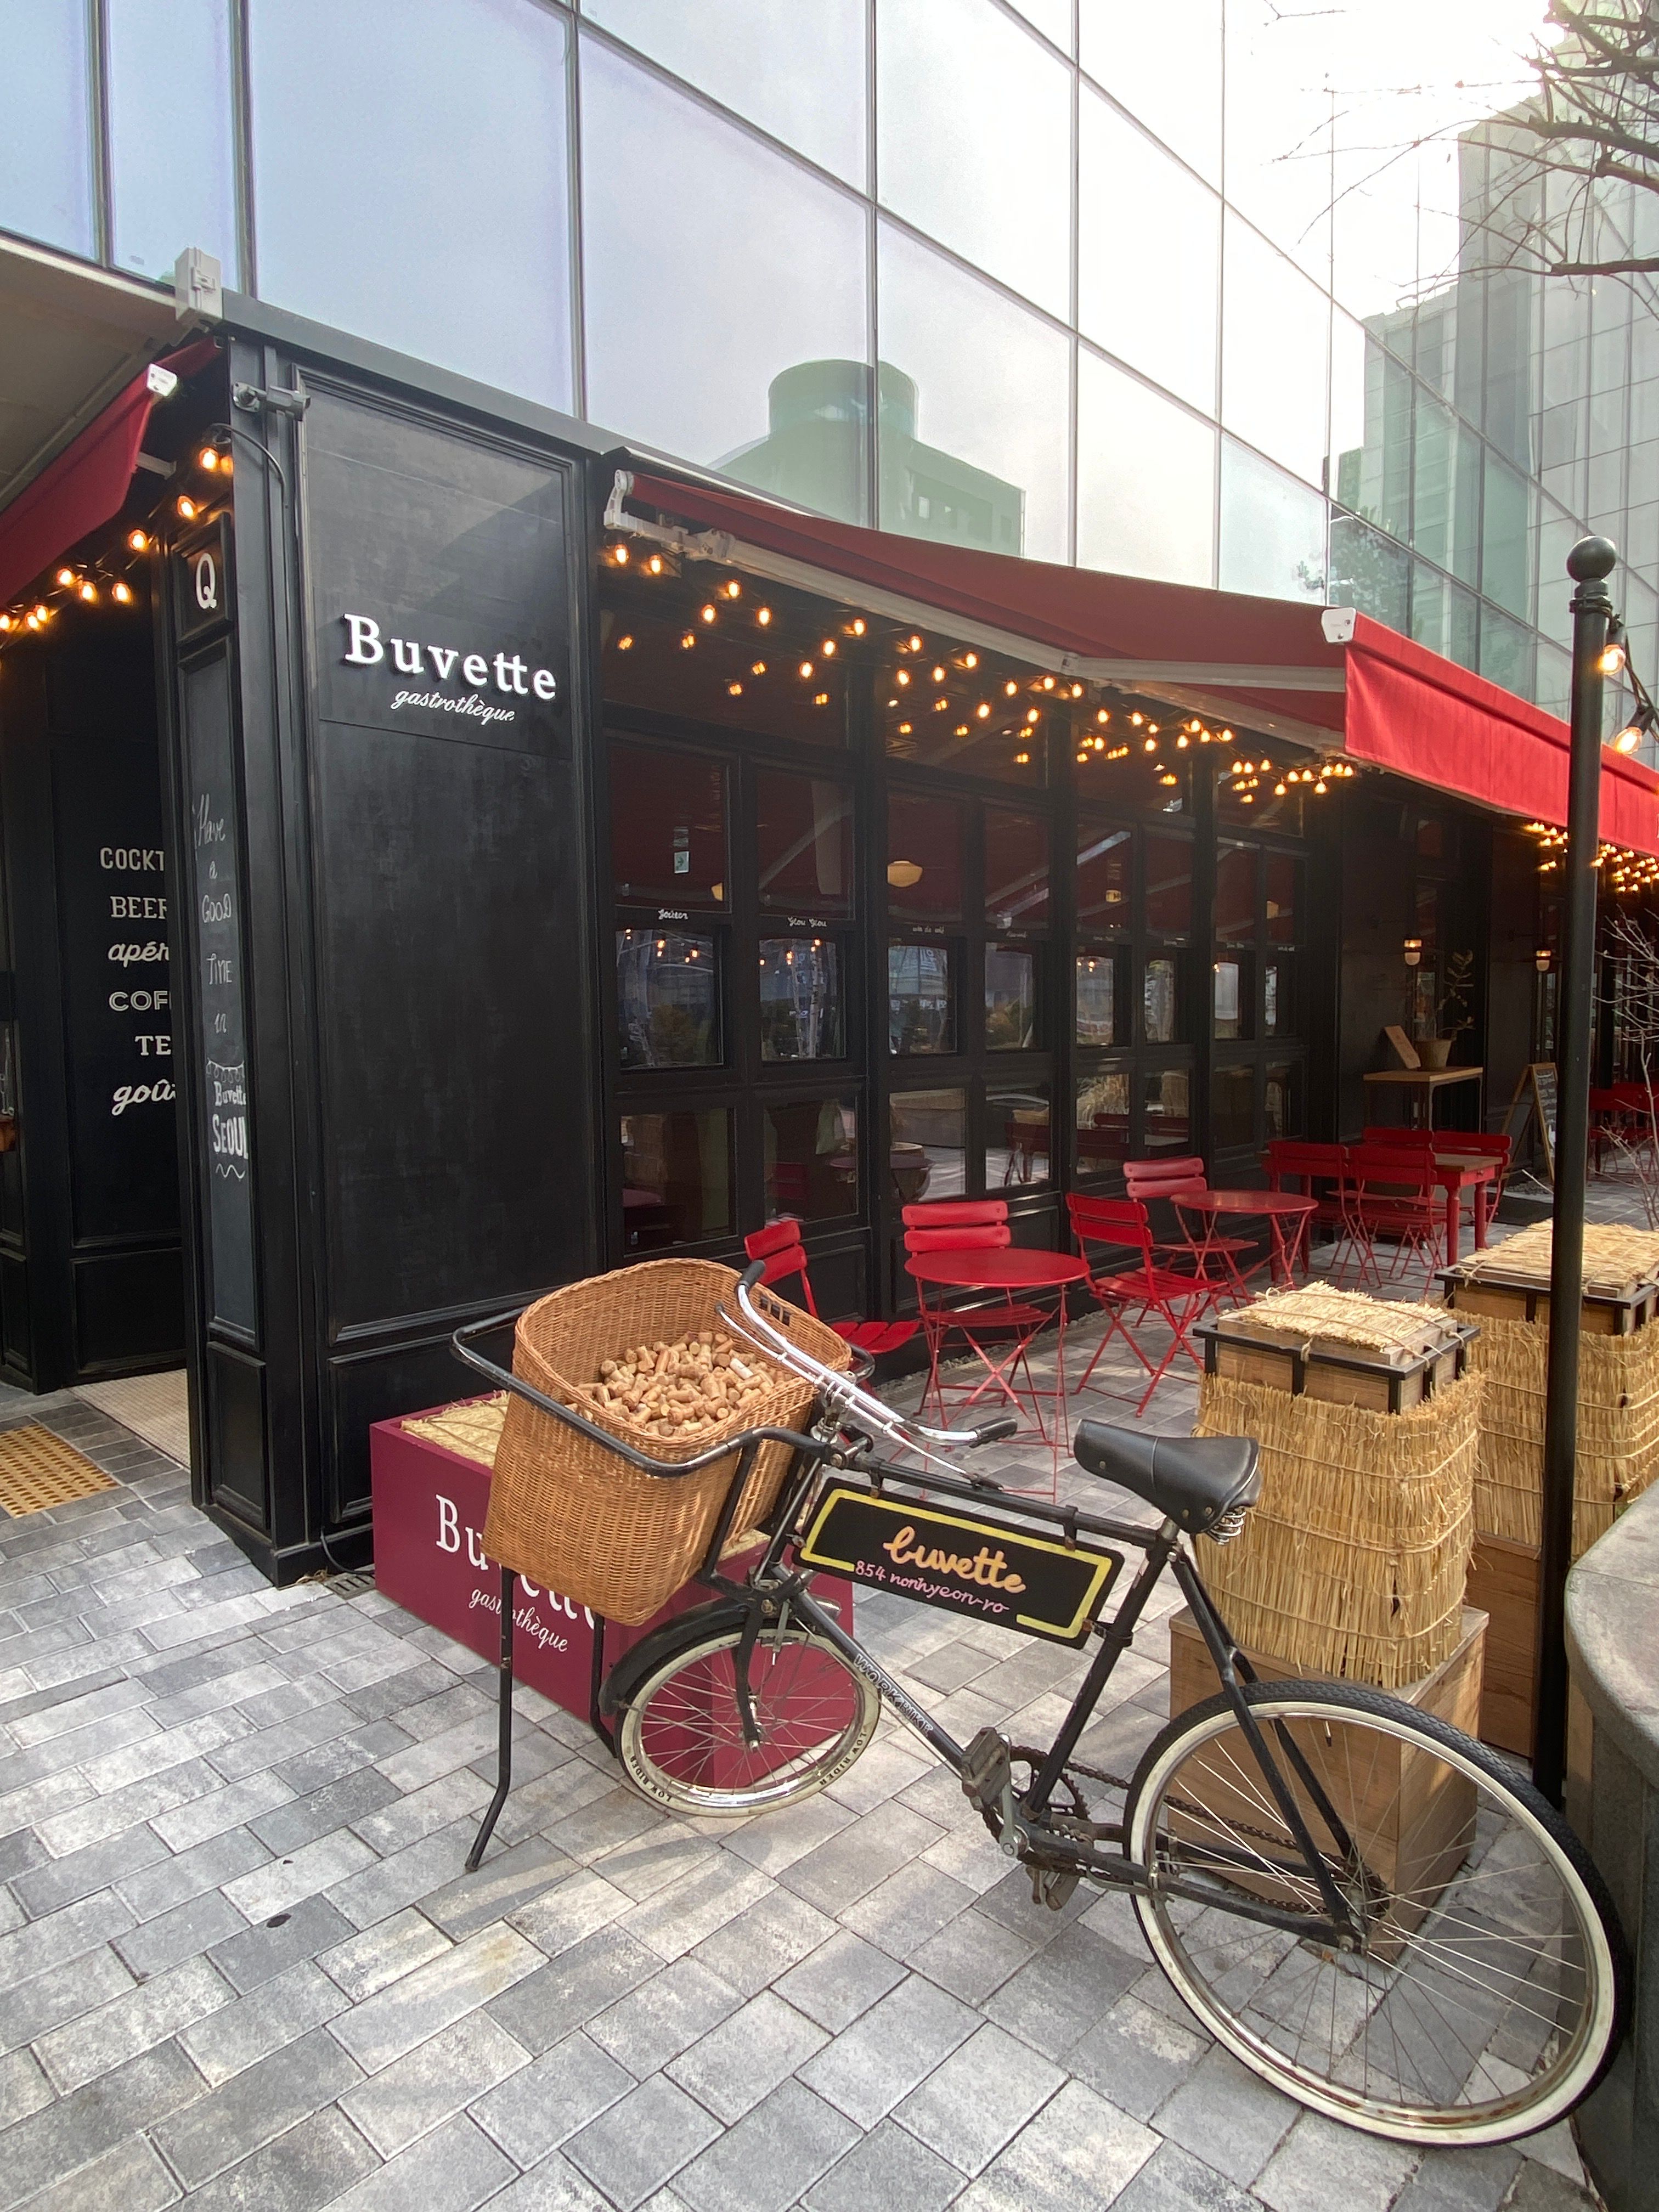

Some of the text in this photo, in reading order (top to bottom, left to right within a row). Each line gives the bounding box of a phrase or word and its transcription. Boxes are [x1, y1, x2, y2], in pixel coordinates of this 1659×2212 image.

[196, 553, 217, 609] Q
[343, 613, 556, 700] Buvette
[390, 690, 515, 725] gastrothèque
[109, 990, 172, 1012] COF
[855, 1560, 1010, 1614] 854 nonhyeon-ro
[882, 1526, 1026, 1594] buvette
